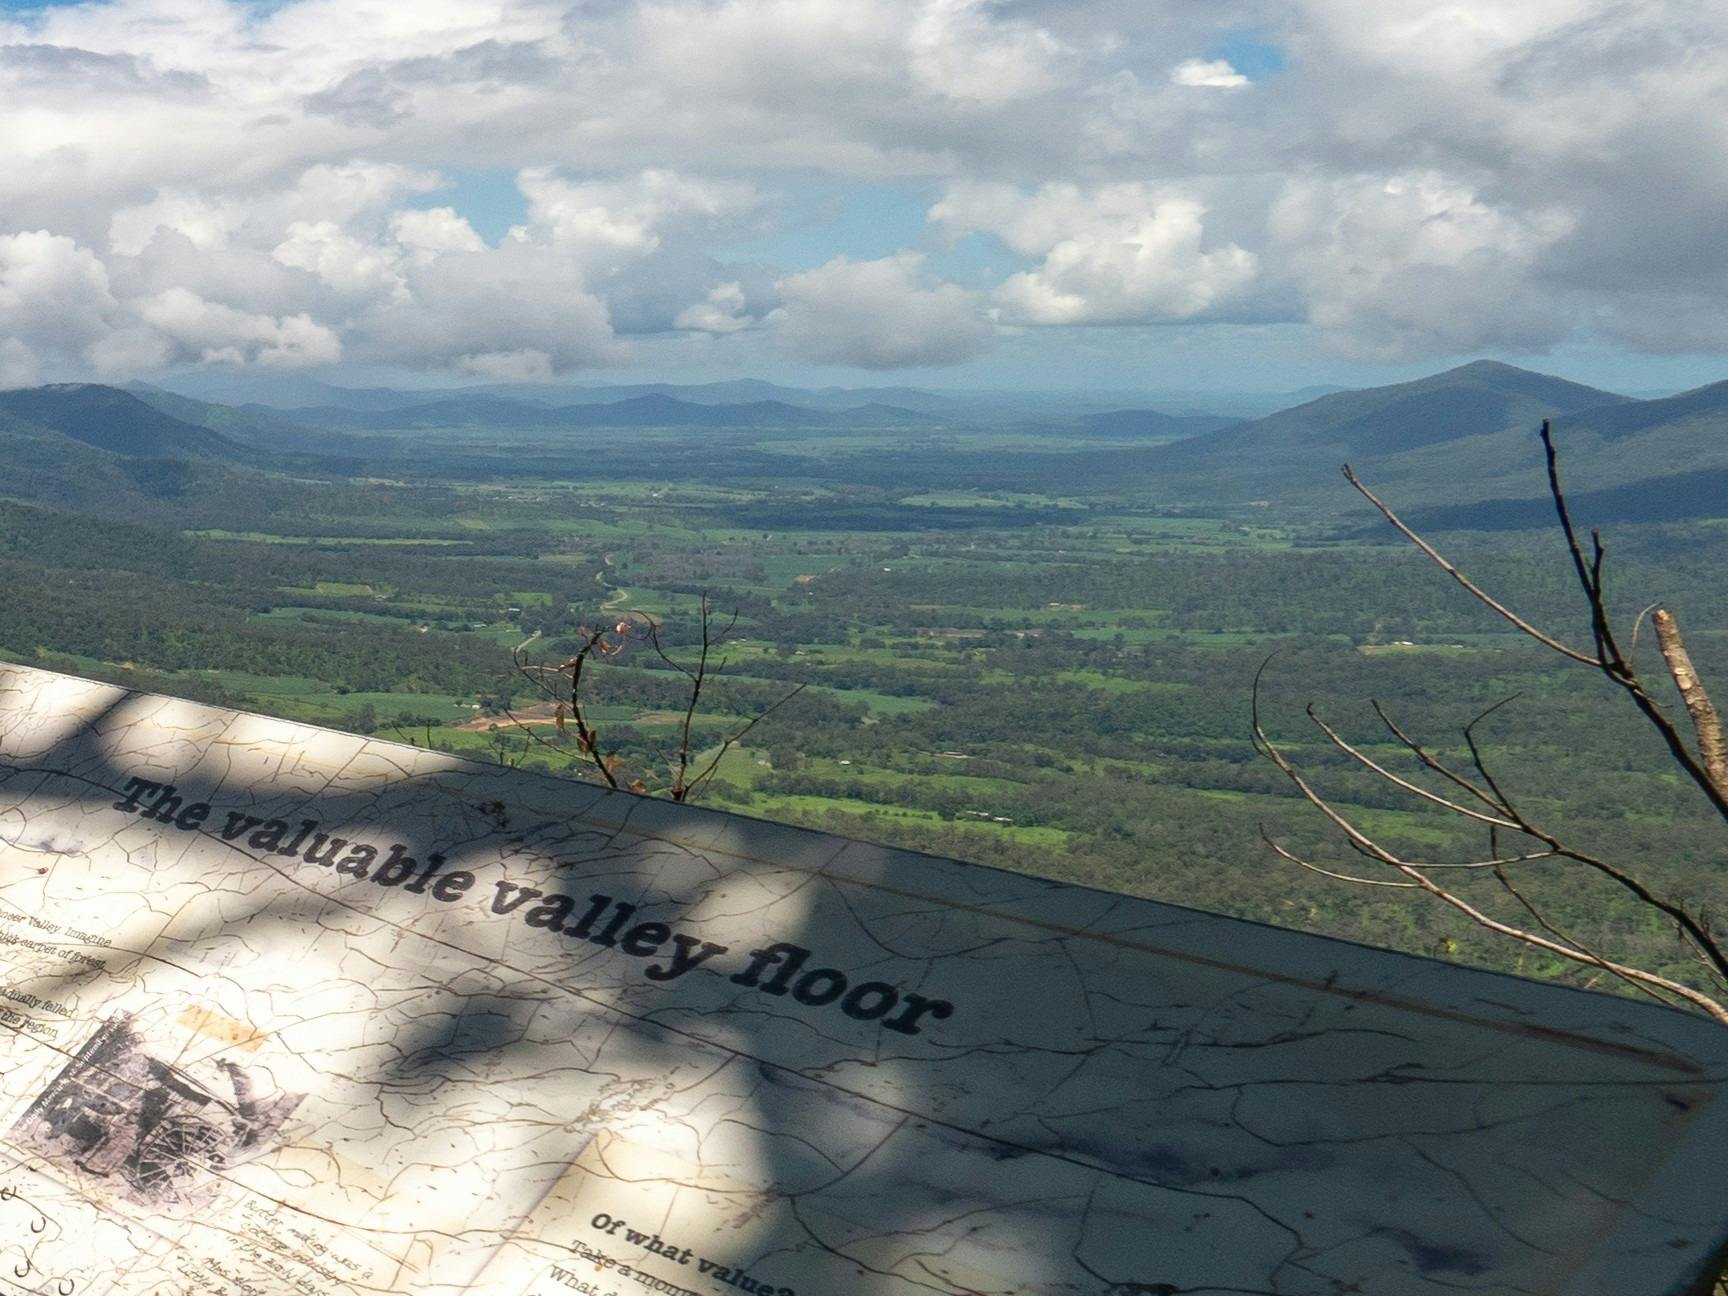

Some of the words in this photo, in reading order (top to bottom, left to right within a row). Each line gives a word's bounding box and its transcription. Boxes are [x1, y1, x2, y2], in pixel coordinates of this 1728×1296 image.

[111, 776, 211, 832] The
[219, 809, 475, 906] valuable
[490, 880, 733, 982] valley
[730, 943, 954, 1037] floor
[62, 927, 111, 947] Imagine
[20, 940, 59, 954] carpet
[69, 952, 109, 968] forest
[0, 1011, 20, 1024] the
[20, 1021, 58, 1037] region
[40, 1001, 75, 1017] felled
[239, 1241, 262, 1259] the
[588, 1214, 626, 1236] Of
[621, 1229, 695, 1265] what
[289, 1249, 344, 1289] industry
[566, 1239, 616, 1269] Take
[618, 1265, 633, 1277] a
[545, 1264, 601, 1296] What
